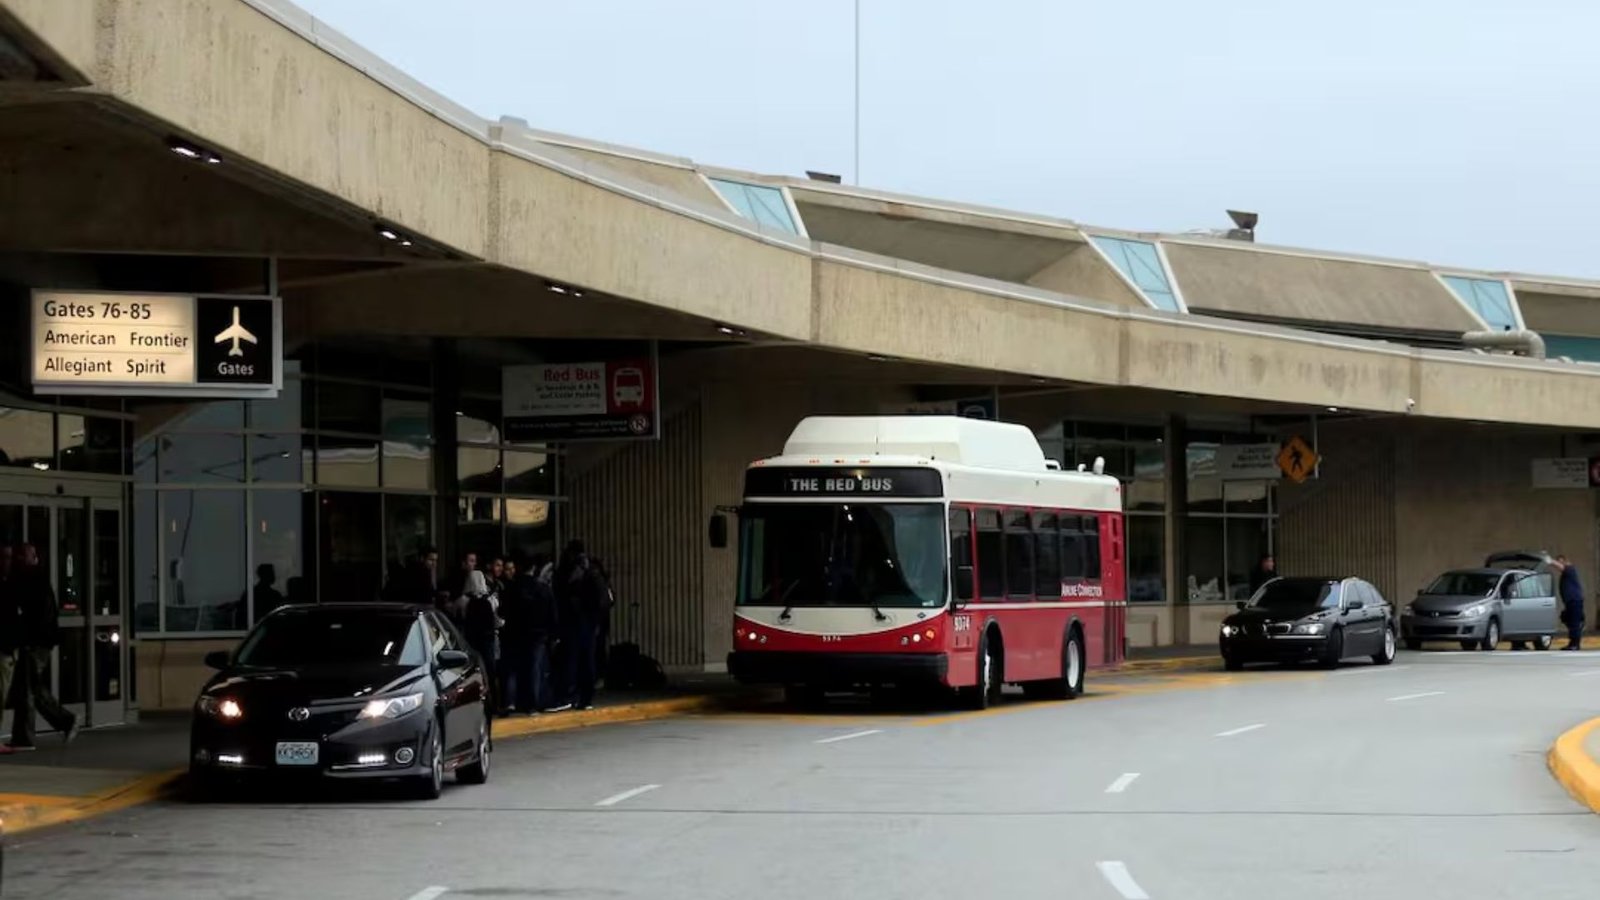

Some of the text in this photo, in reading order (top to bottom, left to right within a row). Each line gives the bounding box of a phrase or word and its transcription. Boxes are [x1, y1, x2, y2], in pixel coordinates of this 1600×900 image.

[44, 301, 151, 320] Gates 76-85
[44, 330, 189, 348] American Frontier
[44, 357, 166, 377] Allegiant Spirit
[217, 362, 255, 376] Gates
[543, 367, 600, 381] Red Bus
[791, 478, 892, 491] THE RED BUS
